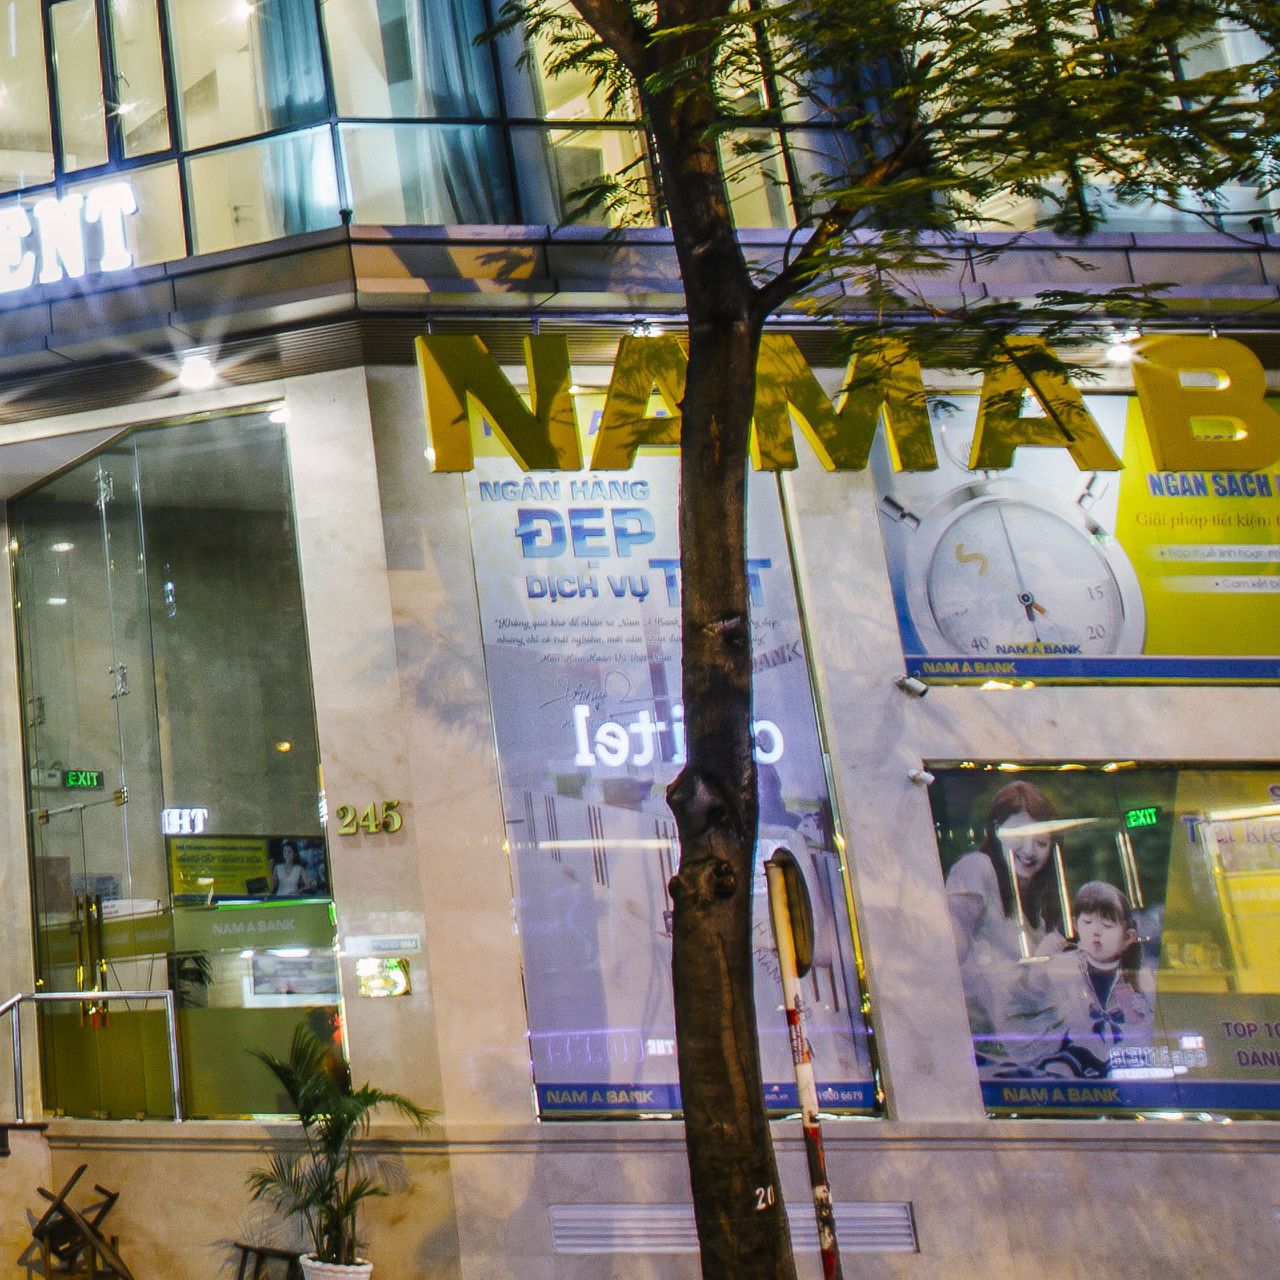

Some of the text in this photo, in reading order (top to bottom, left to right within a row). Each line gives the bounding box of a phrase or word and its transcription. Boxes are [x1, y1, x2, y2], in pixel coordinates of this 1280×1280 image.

[479, 476, 650, 502] NGÂN HÀNG
[515, 507, 656, 569] ĐẸP
[526, 557, 772, 608] DỊCH VỤ TT
[1087, 585, 1105, 601] 15
[1086, 623, 1106, 640] 20
[996, 643, 1082, 655] NAM A BANK
[922, 662, 1016, 674] NAM A BANK
[67, 771, 99, 787] EXIT
[336, 799, 403, 836] 245
[1127, 808, 1157, 827] EXIT
[213, 921, 244, 934] NAM
[258, 919, 295, 932] BANK
[1221, 1021, 1258, 1038] TOP
[545, 1089, 656, 1104] NAM A BANK
[1003, 1087, 1121, 1102] NAM A BANK
